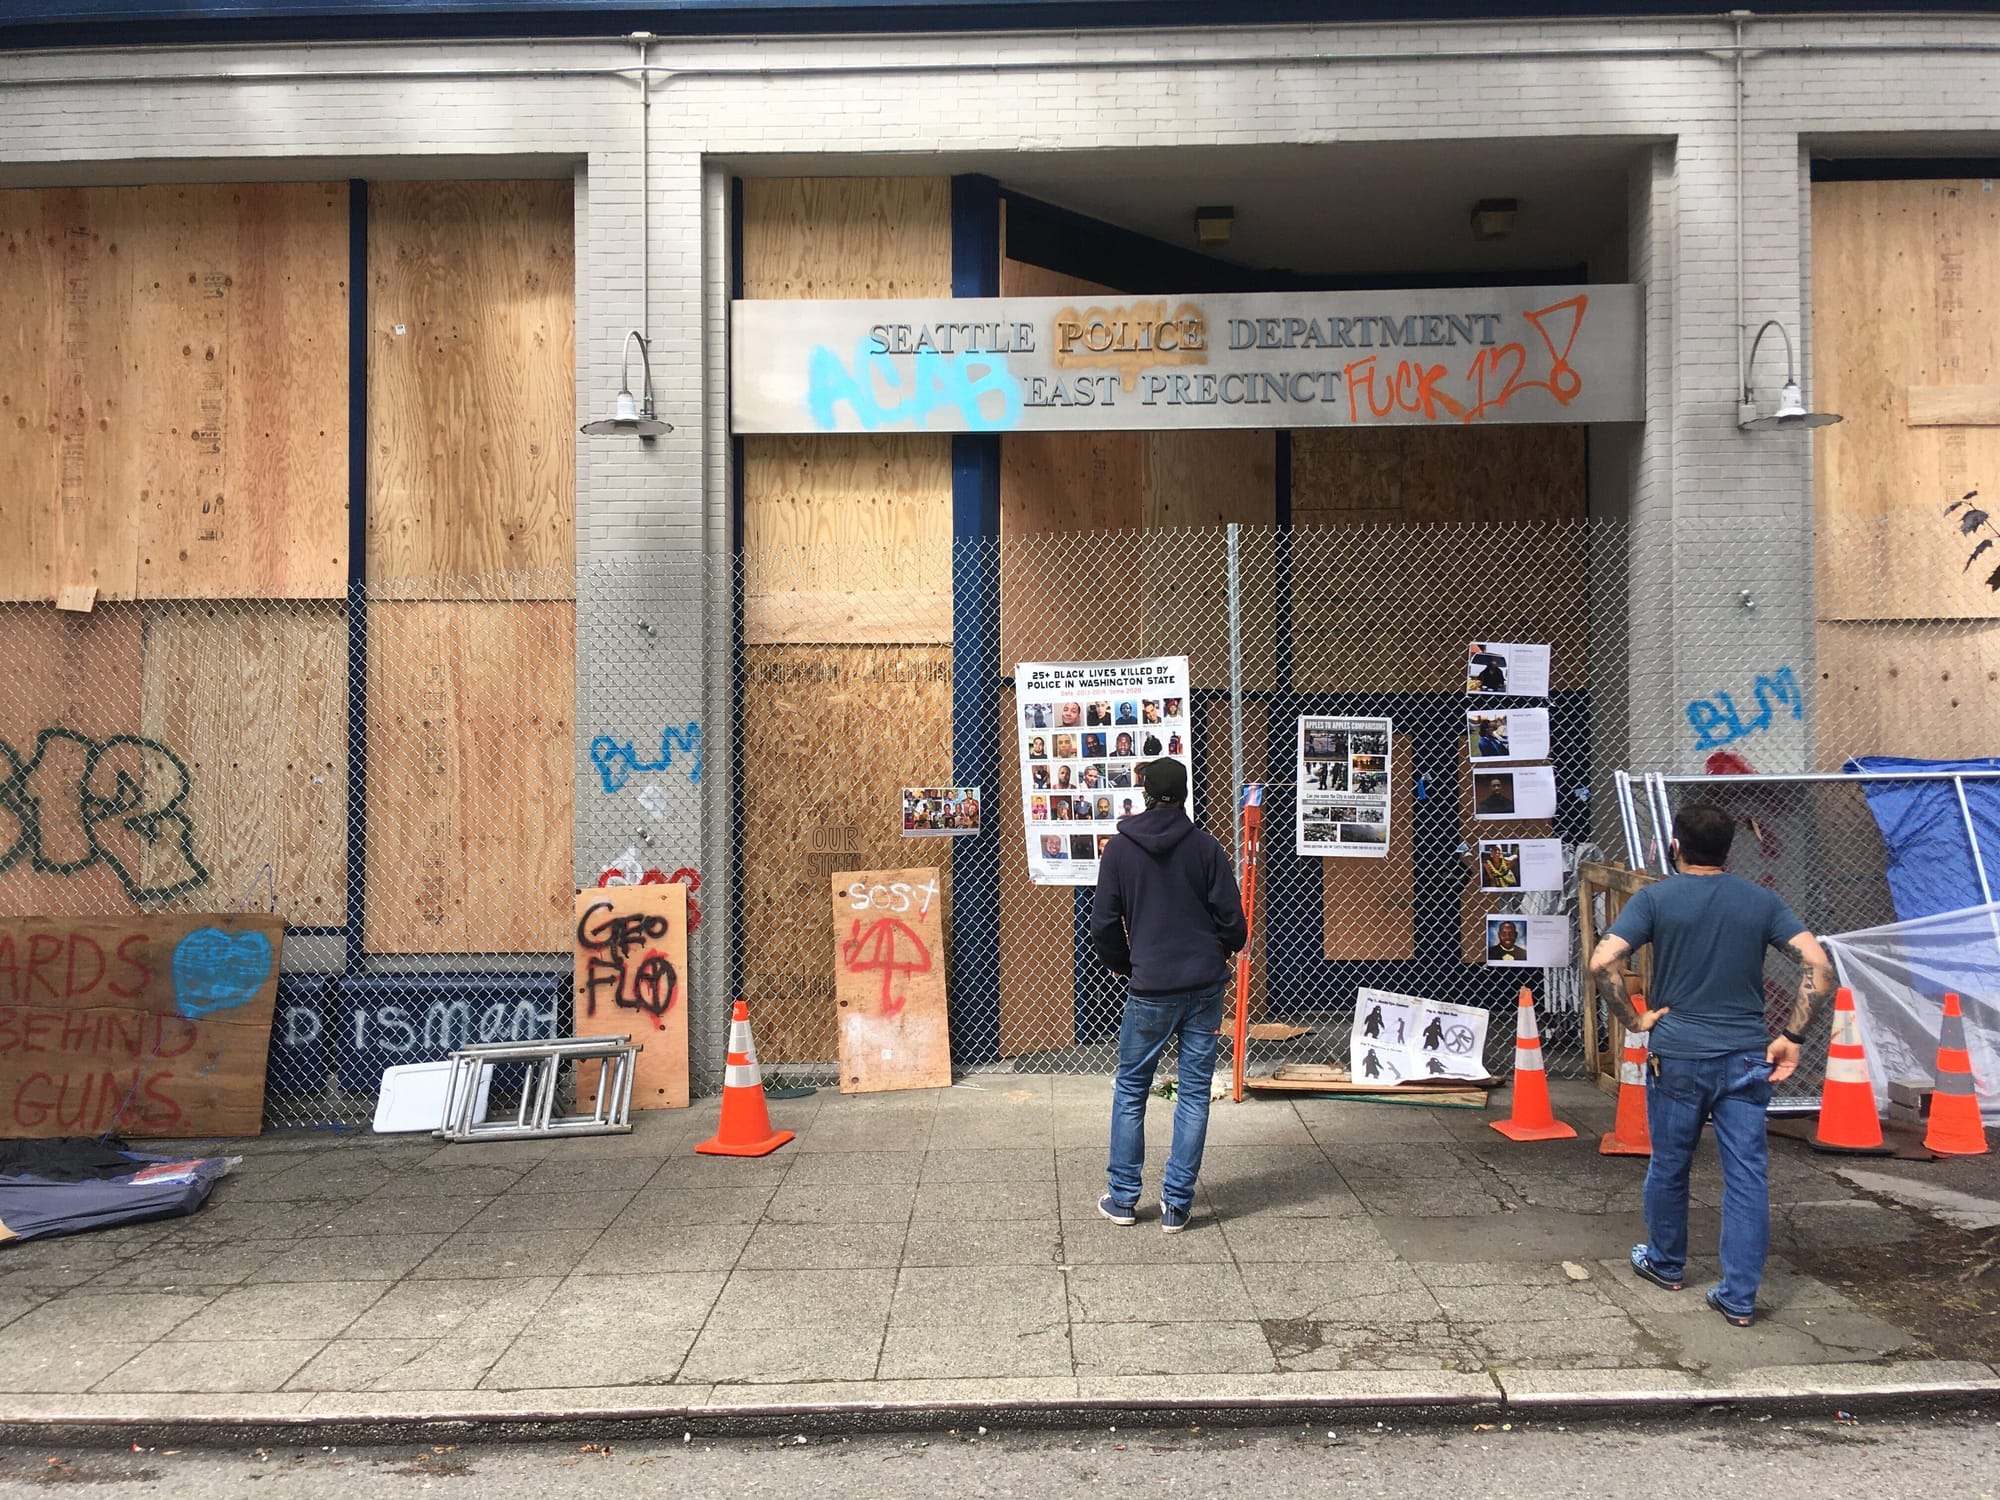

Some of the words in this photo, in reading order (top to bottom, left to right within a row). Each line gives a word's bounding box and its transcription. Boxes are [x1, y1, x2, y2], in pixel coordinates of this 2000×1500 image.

[868, 322, 1036, 356] SEATTLE
[1058, 317, 1206, 353] POLICE
[1227, 312, 1502, 350] DEPARTMENT
[807, 334, 1024, 433] ACAB
[1022, 374, 1121, 408] EAST
[1141, 370, 1343, 406] PRECINCT
[1343, 355, 1468, 424] FUCK
[1027, 680, 1061, 690] POLICE
[1065, 679, 1075, 689] IN
[1078, 676, 1143, 688] WASHINGTON
[1147, 675, 1176, 685] STATE
[1032, 671, 1050, 680] 25+
[1054, 669, 1085, 679] BLACK
[1089, 668, 1117, 678] LIVES
[1120, 666, 1153, 677] KILLED
[1156, 665, 1169, 675] BY
[1686, 665, 1803, 752] BLM
[812, 826, 859, 852] OUR
